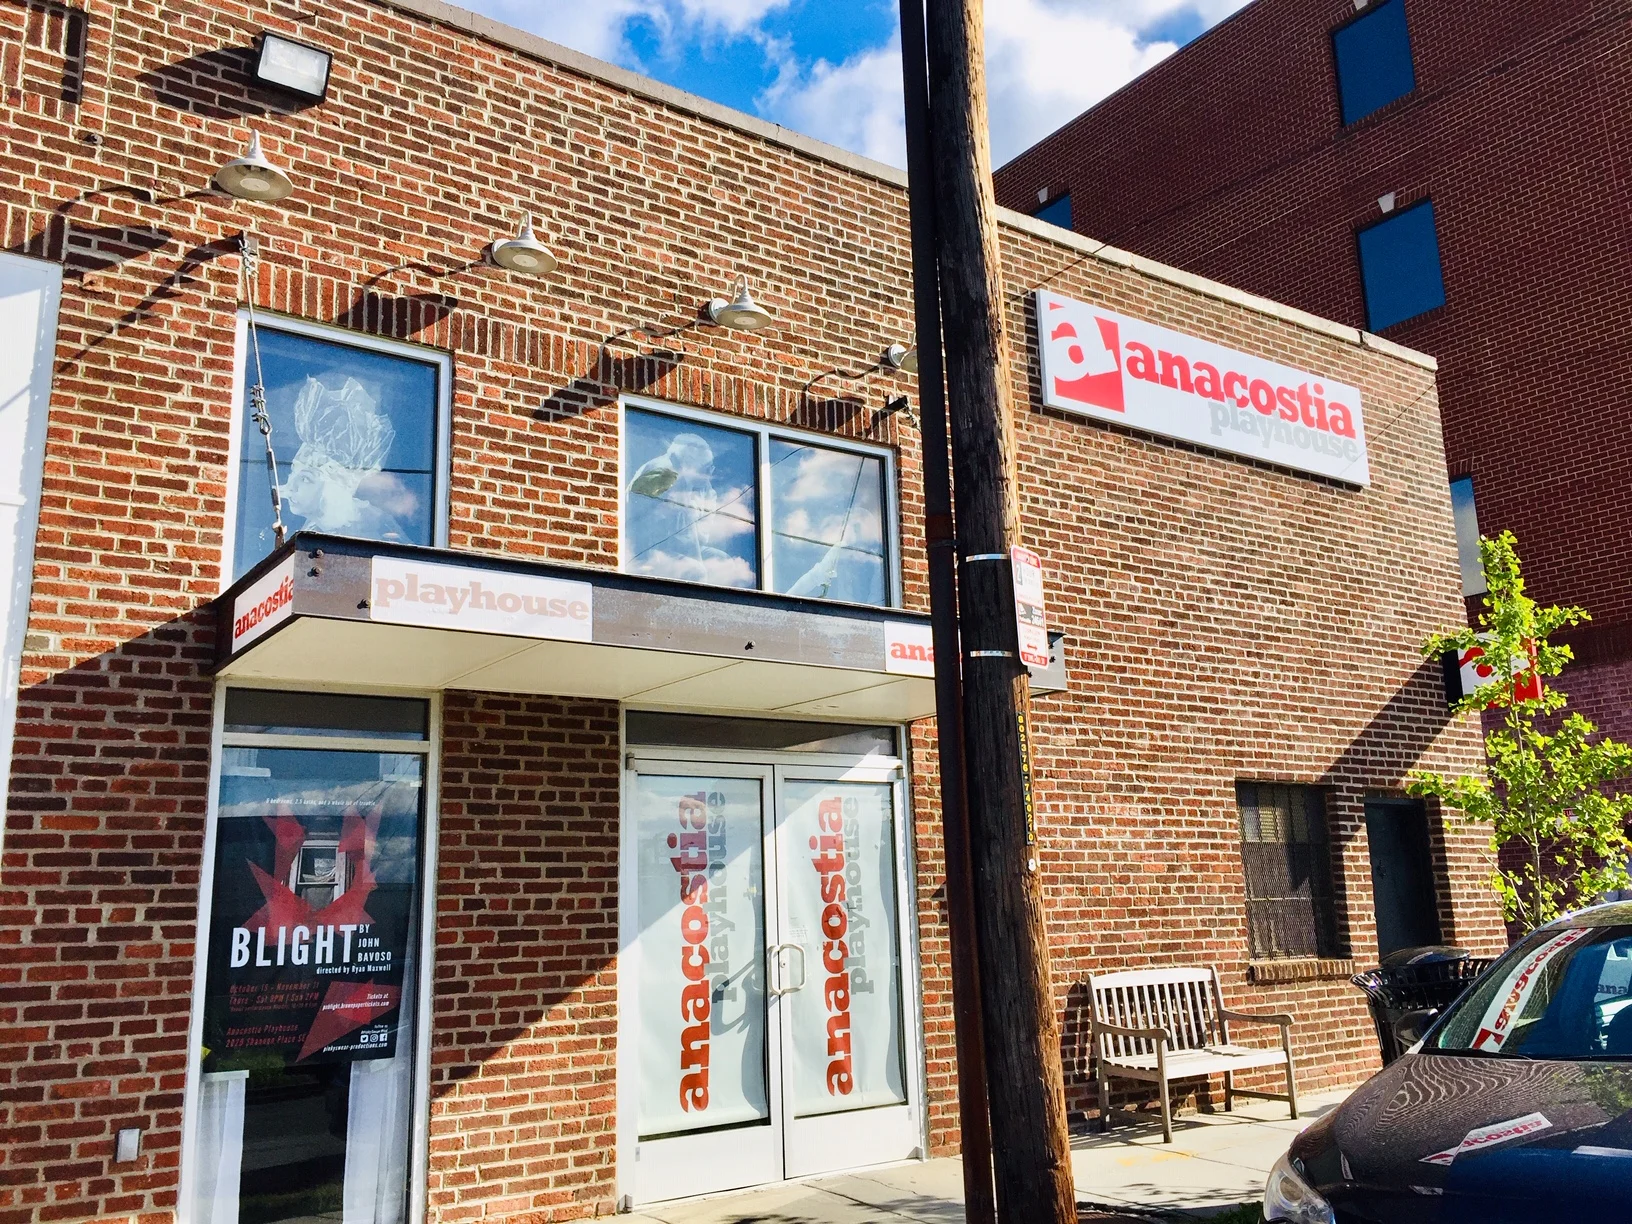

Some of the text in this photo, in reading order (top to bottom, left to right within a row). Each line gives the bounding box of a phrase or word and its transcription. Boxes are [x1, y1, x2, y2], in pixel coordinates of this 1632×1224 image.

[1125, 340, 1357, 440] anacostia
[1207, 397, 1359, 463] playhouse
[375, 573, 591, 621] playhouse
[704, 791, 737, 1005] playhouse
[844, 796, 875, 996] playhouse
[230, 924, 357, 968] BLIGHT
[357, 951, 392, 962] BAVOSO
[358, 937, 380, 948] JOHN
[359, 923, 370, 934] BY
[667, 791, 711, 1114] anacostia
[809, 796, 854, 1097] anacostia
[316, 964, 391, 974] directed by Ryan Maxwell
